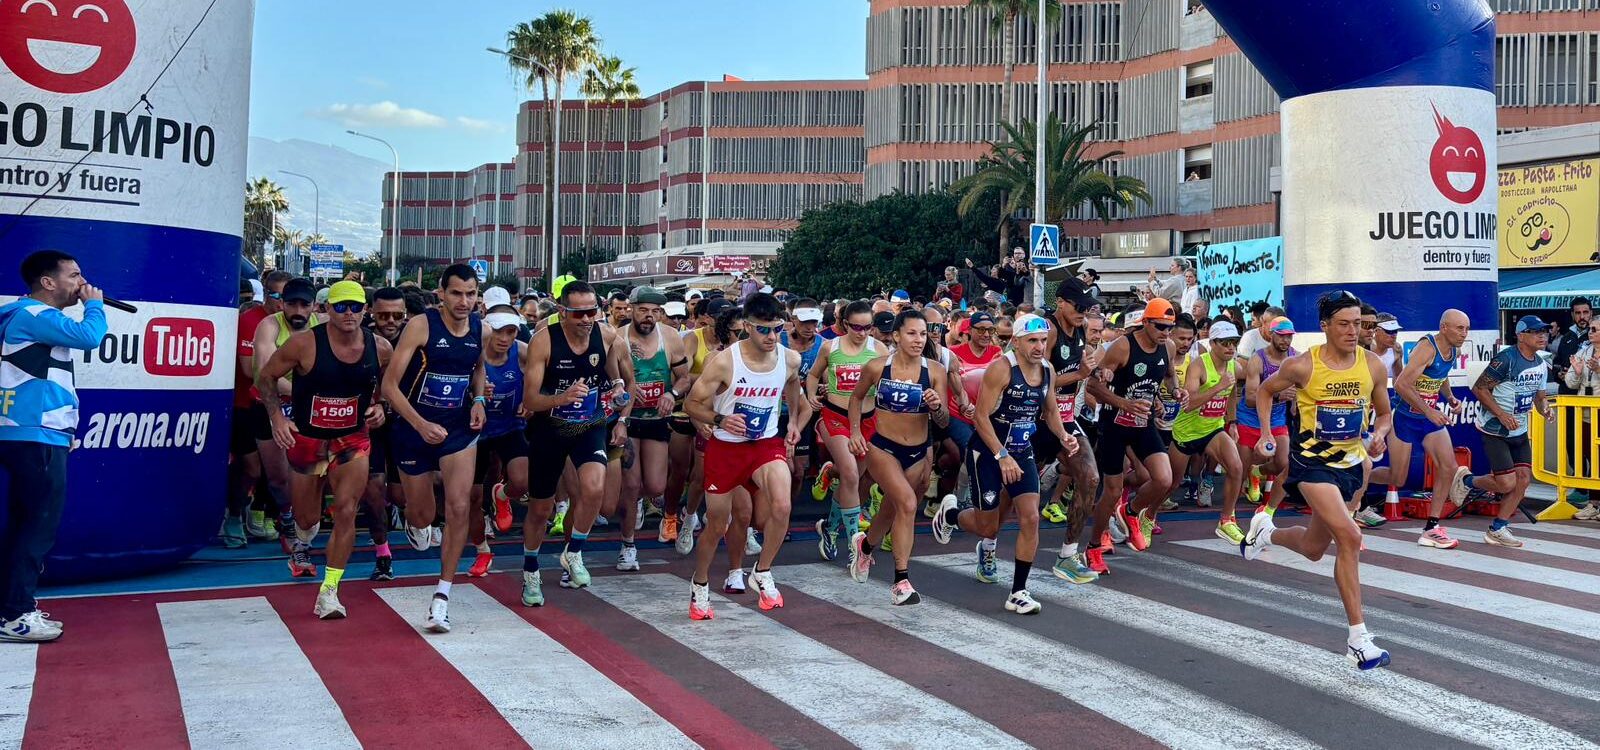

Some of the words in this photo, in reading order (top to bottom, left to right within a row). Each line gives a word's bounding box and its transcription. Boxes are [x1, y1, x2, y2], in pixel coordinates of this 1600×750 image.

[60, 106, 215, 167] LIMPIO
[1523, 165, 1556, 184] Pasta
[1563, 161, 1592, 181] Frito
[57, 172, 72, 193] y
[79, 169, 141, 195] fuera
[1369, 211, 1459, 240] JUEGO
[1423, 249, 1461, 264] dentro
[1464, 252, 1470, 266] y
[1472, 249, 1491, 264] fuera
[1500, 295, 1541, 309] CAFETERIA
[1545, 295, 1551, 308] Y
[152, 325, 211, 367] Tube
[442, 384, 452, 396] 9
[1325, 381, 1360, 390] CORRE
[734, 387, 778, 397] BIKILA
[892, 391, 909, 403] 12
[493, 400, 501, 408] 7
[320, 405, 354, 417] 1509
[750, 416, 760, 427] 4
[1336, 417, 1346, 428] 3
[1023, 431, 1030, 441] 6
